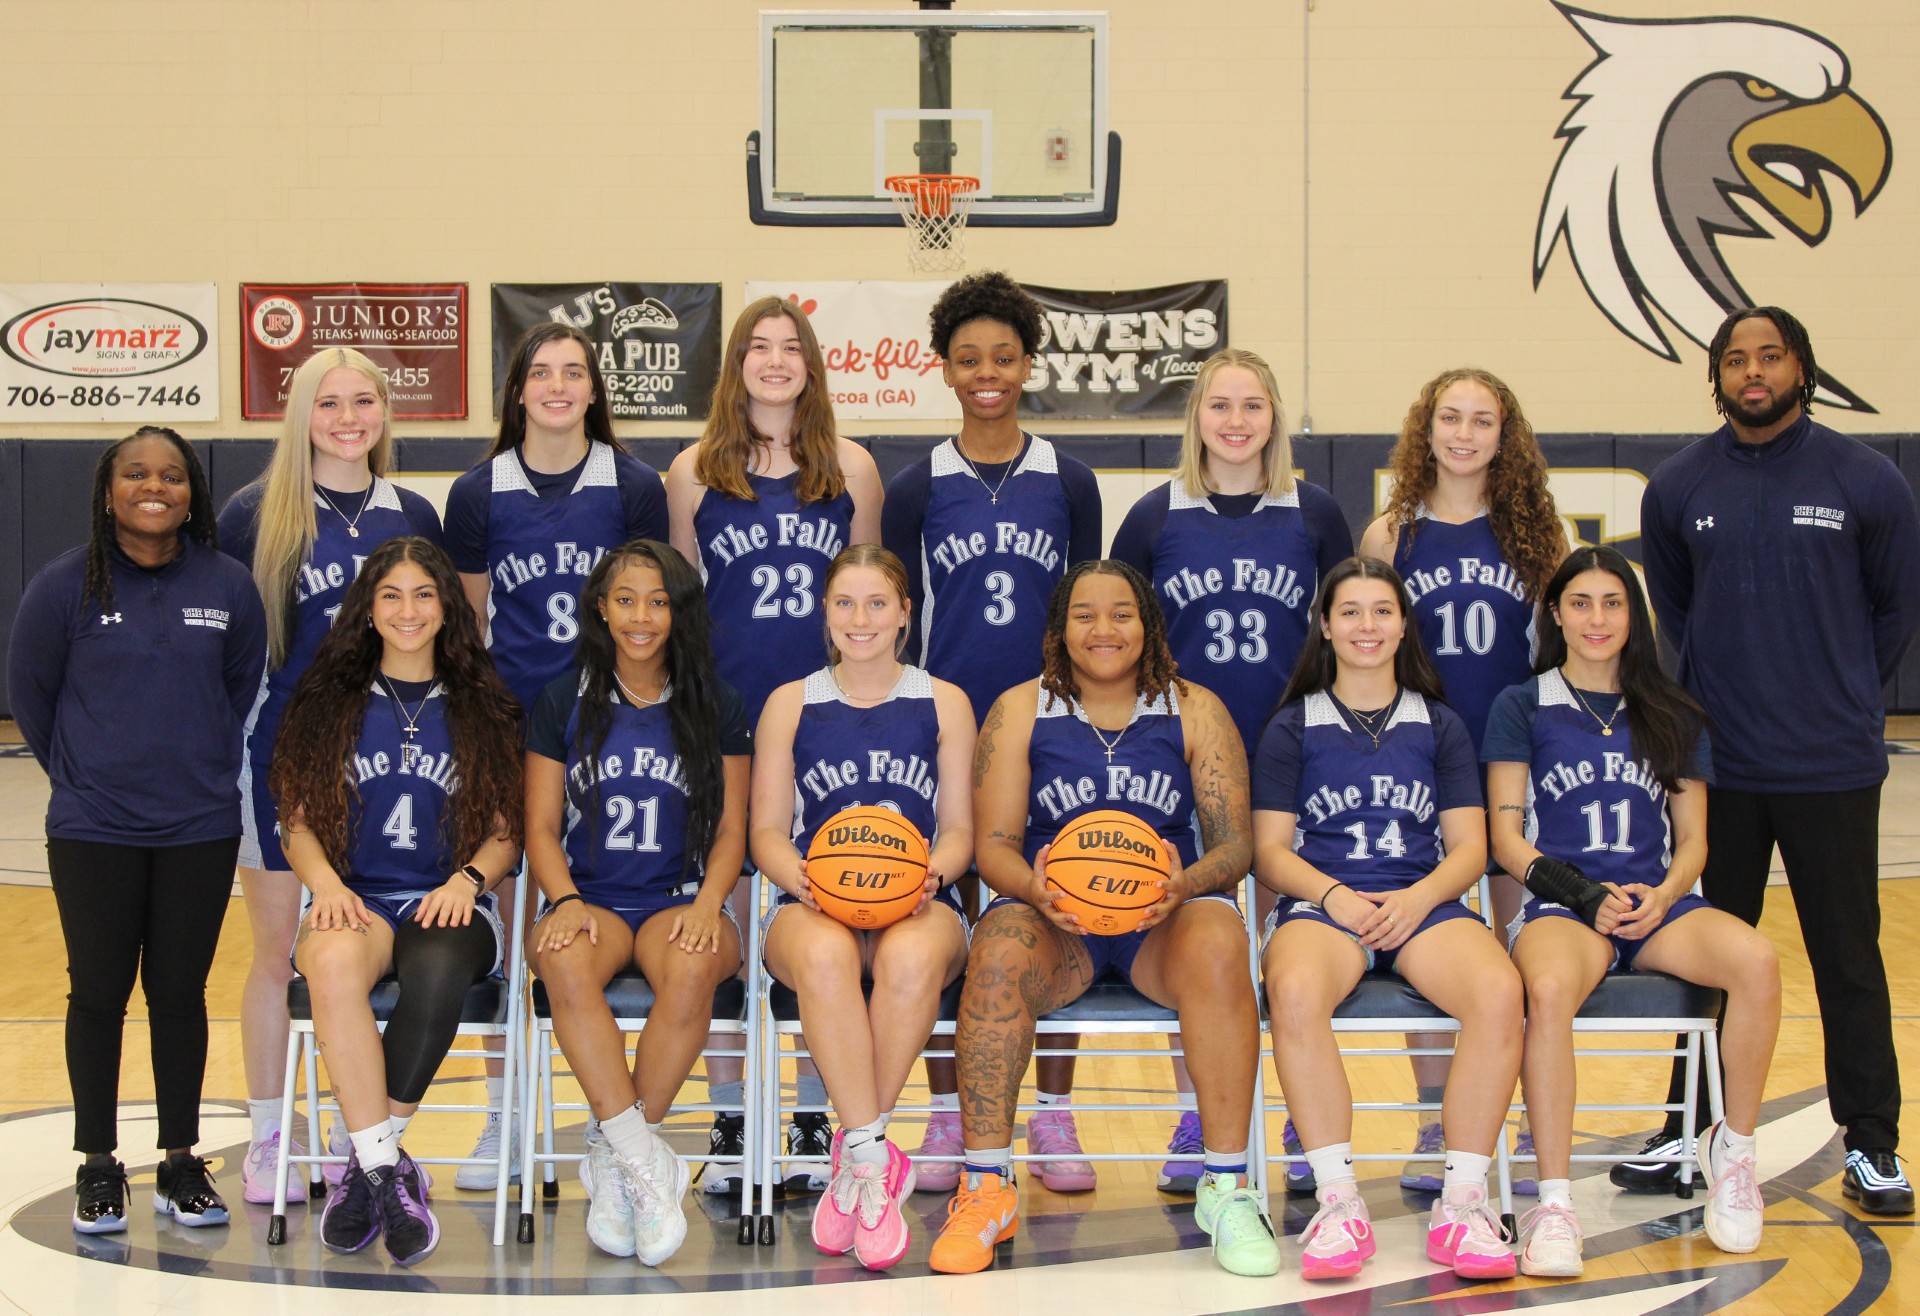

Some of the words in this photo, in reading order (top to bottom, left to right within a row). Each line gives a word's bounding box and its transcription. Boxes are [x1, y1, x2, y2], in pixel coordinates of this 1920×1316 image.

[258, 301, 276, 314] BAR
[280, 301, 298, 315] AND
[312, 305, 459, 327] JUNIOR'S
[548, 286, 617, 328] AJ'S
[43, 321, 182, 353] jaymarz
[96, 350, 126, 359] SIGNS
[131, 351, 138, 359] &
[143, 351, 181, 359] GRAF-X
[262, 335, 295, 346] GRILL
[312, 328, 353, 340] STEAKS
[360, 329, 401, 340] WINGS
[404, 329, 458, 341] SEAFOOD
[624, 338, 680, 370] PUB
[1022, 352, 1139, 392] GYM
[1141, 359, 1158, 380] of
[7, 385, 201, 406] 706-886-7446
[613, 403, 648, 414] down
[651, 403, 687, 415] south
[633, 392, 657, 402] GA
[876, 389, 916, 407] (GA)
[1793, 505, 1815, 516] THE
[1815, 506, 1845, 521] FALLS
[708, 523, 768, 567] The
[932, 531, 987, 575] The
[994, 521, 1059, 573] Falls
[495, 552, 547, 593] The
[555, 541, 610, 576] Fal
[1163, 566, 1223, 610] The
[1231, 557, 1305, 609] Falls
[1403, 565, 1452, 606] The
[1458, 557, 1528, 602] Falls
[751, 562, 815, 619] 23
[983, 570, 1016, 626] 3
[182, 607, 203, 618] THE
[546, 591, 580, 644] 8
[1434, 599, 1497, 656] 10
[1204, 608, 1269, 664] 33
[802, 758, 859, 802] The
[867, 749, 935, 800] Falls
[1036, 775, 1097, 821] The
[1105, 765, 1182, 816] Falls
[1540, 759, 1596, 802] The
[1304, 784, 1362, 825] The
[1370, 774, 1435, 824] Falls
[382, 793, 418, 850] 4
[605, 794, 662, 853] 21
[827, 825, 908, 854] Wilson
[1344, 819, 1407, 860] 14
[1580, 798, 1636, 853] 11
[1077, 830, 1157, 862] Wilson
